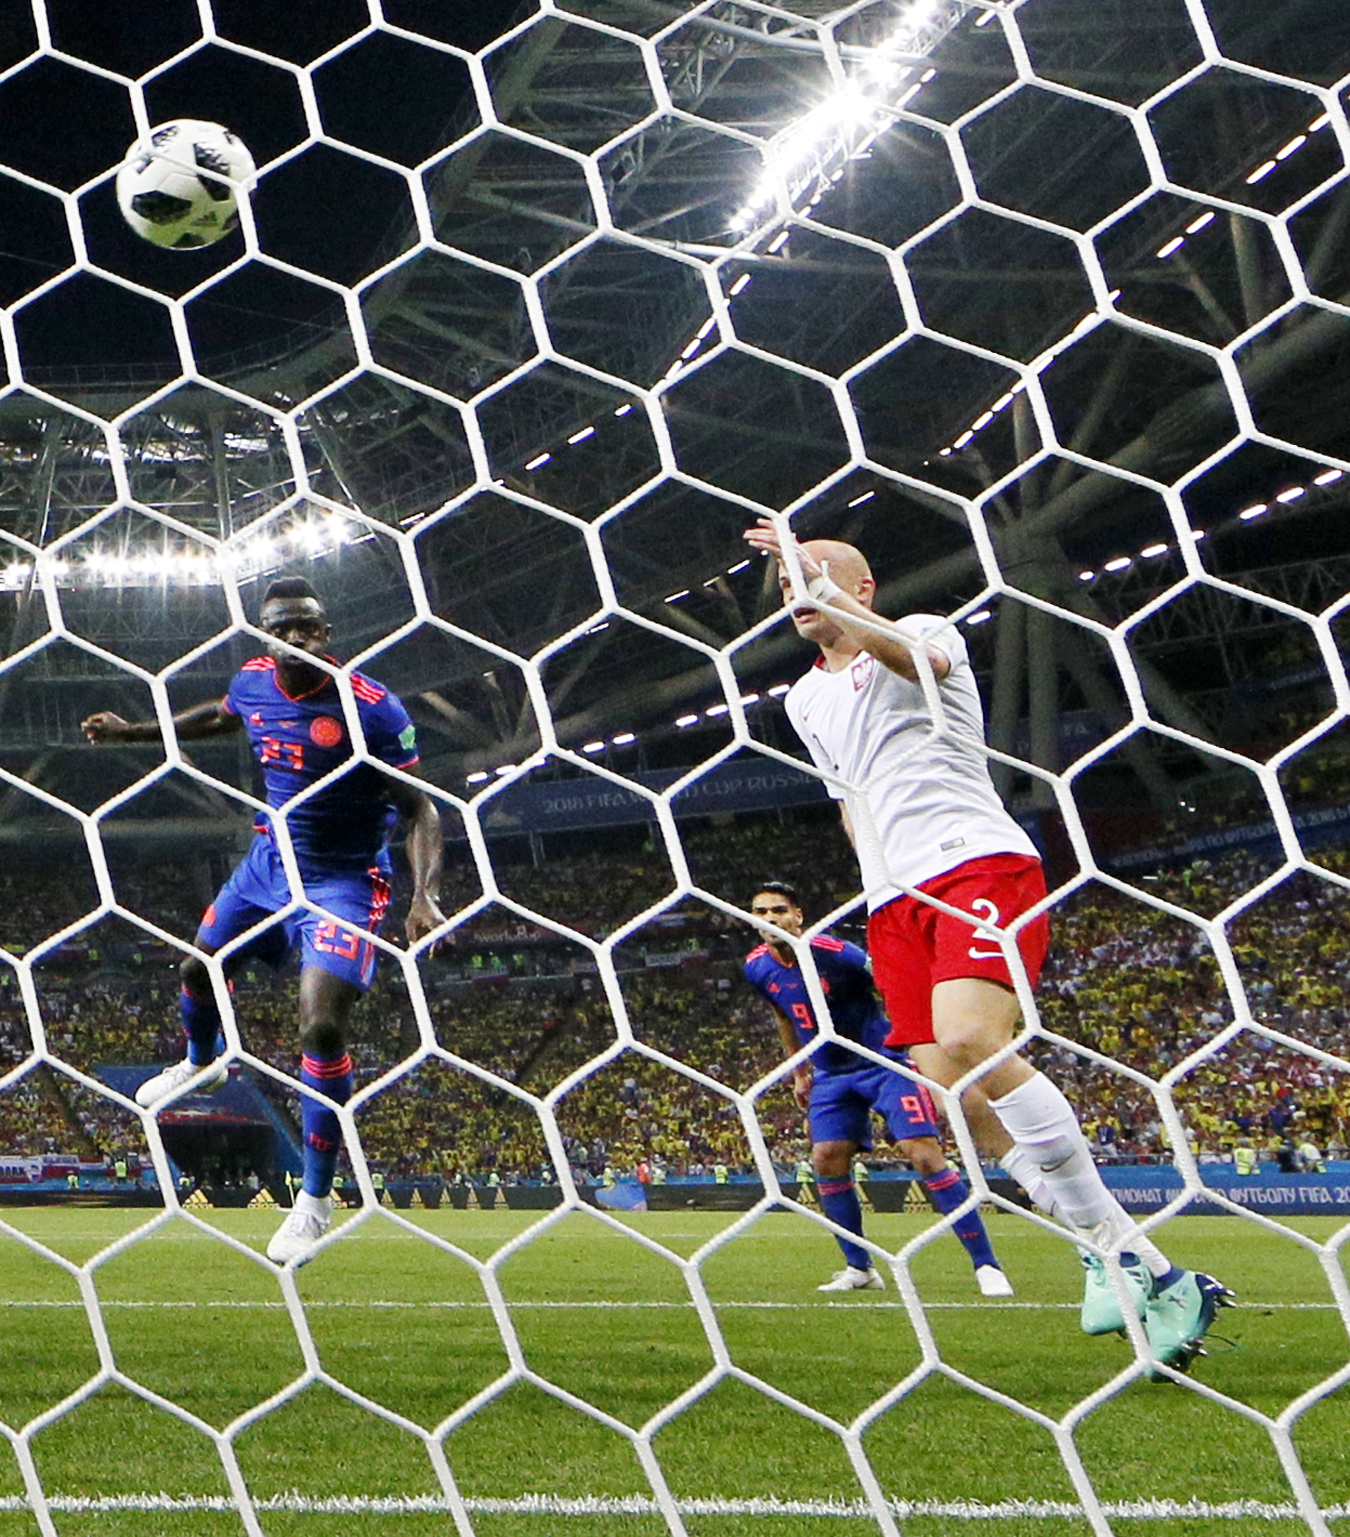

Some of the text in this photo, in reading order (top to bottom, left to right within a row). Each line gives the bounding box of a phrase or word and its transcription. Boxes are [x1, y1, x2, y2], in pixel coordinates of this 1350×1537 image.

[260, 736, 304, 770] 23
[543, 798, 584, 814] 2018
[587, 793, 627, 809] FIFA
[701, 778, 743, 796] CUP
[971, 897, 1000, 943] 2
[313, 919, 361, 961] 23
[791, 1003, 815, 1030] 9
[900, 1095, 925, 1123] 9
[1229, 1187, 1295, 1204] ФУТБОЛУ
[1298, 1187, 1333, 1204] FIFA
